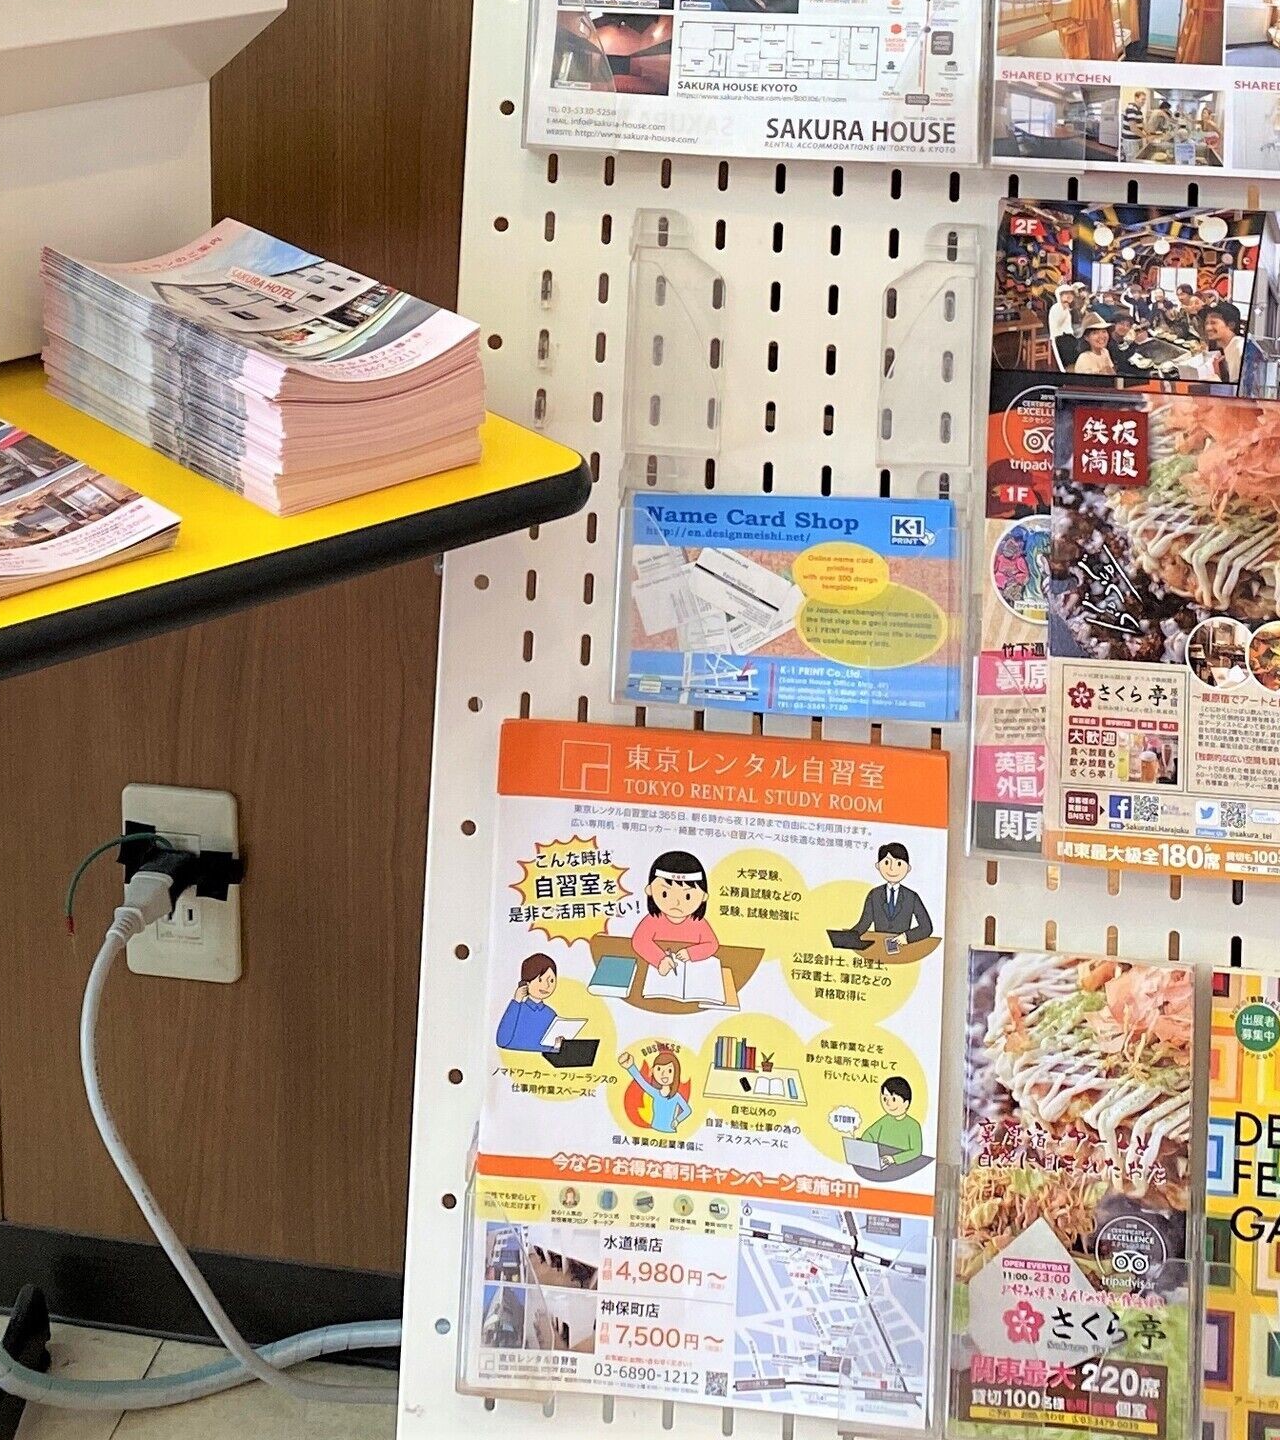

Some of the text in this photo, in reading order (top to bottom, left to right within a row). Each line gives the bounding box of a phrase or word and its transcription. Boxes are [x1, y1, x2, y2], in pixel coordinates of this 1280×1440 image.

[1002, 70, 1111, 83] SHARED KITCHEN
[766, 118, 955, 144] SAKURA HOUSE
[1014, 219, 1038, 233] 2F
[231, 269, 297, 300] SAKURA HOTEL
[647, 506, 859, 533] Name Card Shop
[895, 518, 922, 535] K-1
[892, 537, 919, 545] PRINT
[1098, 684, 1168, 706] さくら亭
[625, 745, 885, 789] 東京レンタル自習室
[625, 779, 884, 813] TOKYO RENTAL STUDY ROOM
[535, 850, 612, 867] こんな時は
[536, 873, 616, 898] 自習室を
[719, 886, 801, 902] 公務員試験などの
[719, 904, 799, 921] 受験、試験勉強に
[1242, 1014, 1275, 1027] 出展者
[1241, 1029, 1275, 1042] 募集中
[603, 1235, 662, 1253] 水道橋店
[600, 1300, 660, 1318] 神保町店
[1052, 1306, 1166, 1349] さくら亭
[594, 1364, 699, 1386] 03-6890-1212
